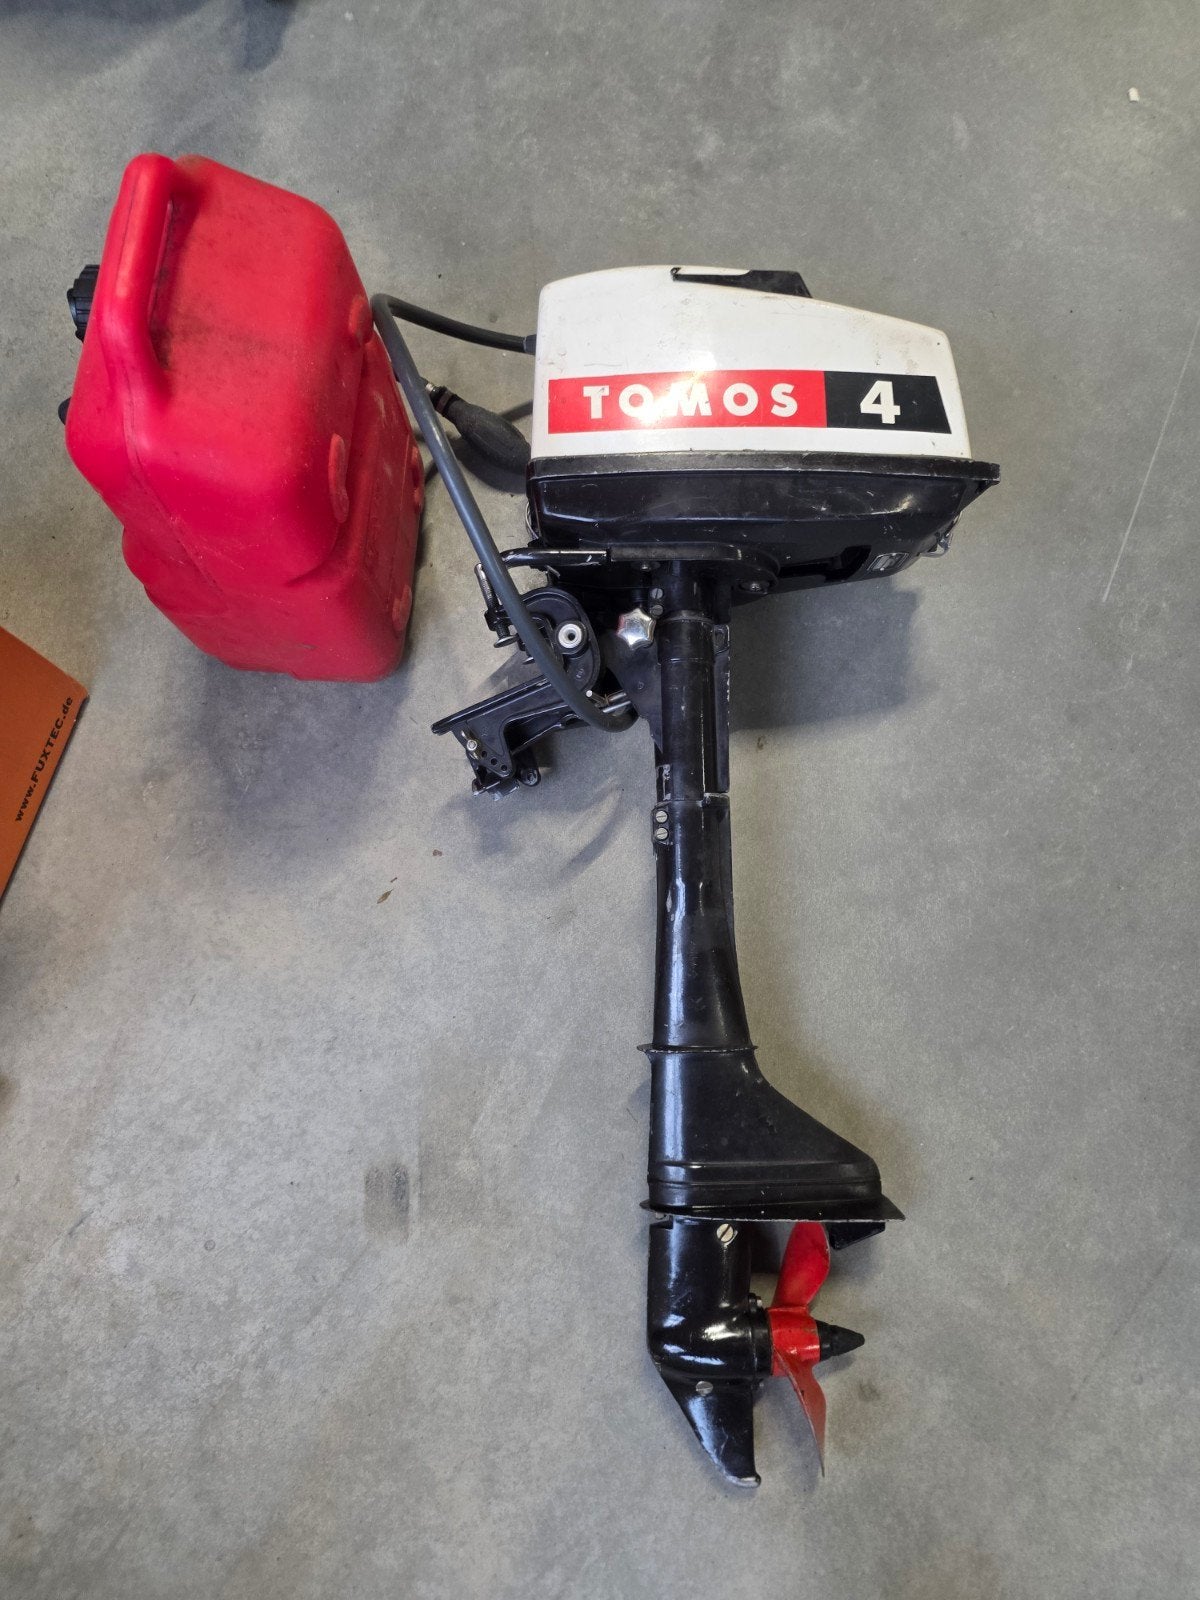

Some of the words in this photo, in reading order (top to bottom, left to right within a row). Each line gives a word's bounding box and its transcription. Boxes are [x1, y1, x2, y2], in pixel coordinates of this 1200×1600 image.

[583, 383, 798, 419] TOMOS
[860, 381, 900, 424] 4
[15, 697, 73, 822] www.FUXTEC.de
